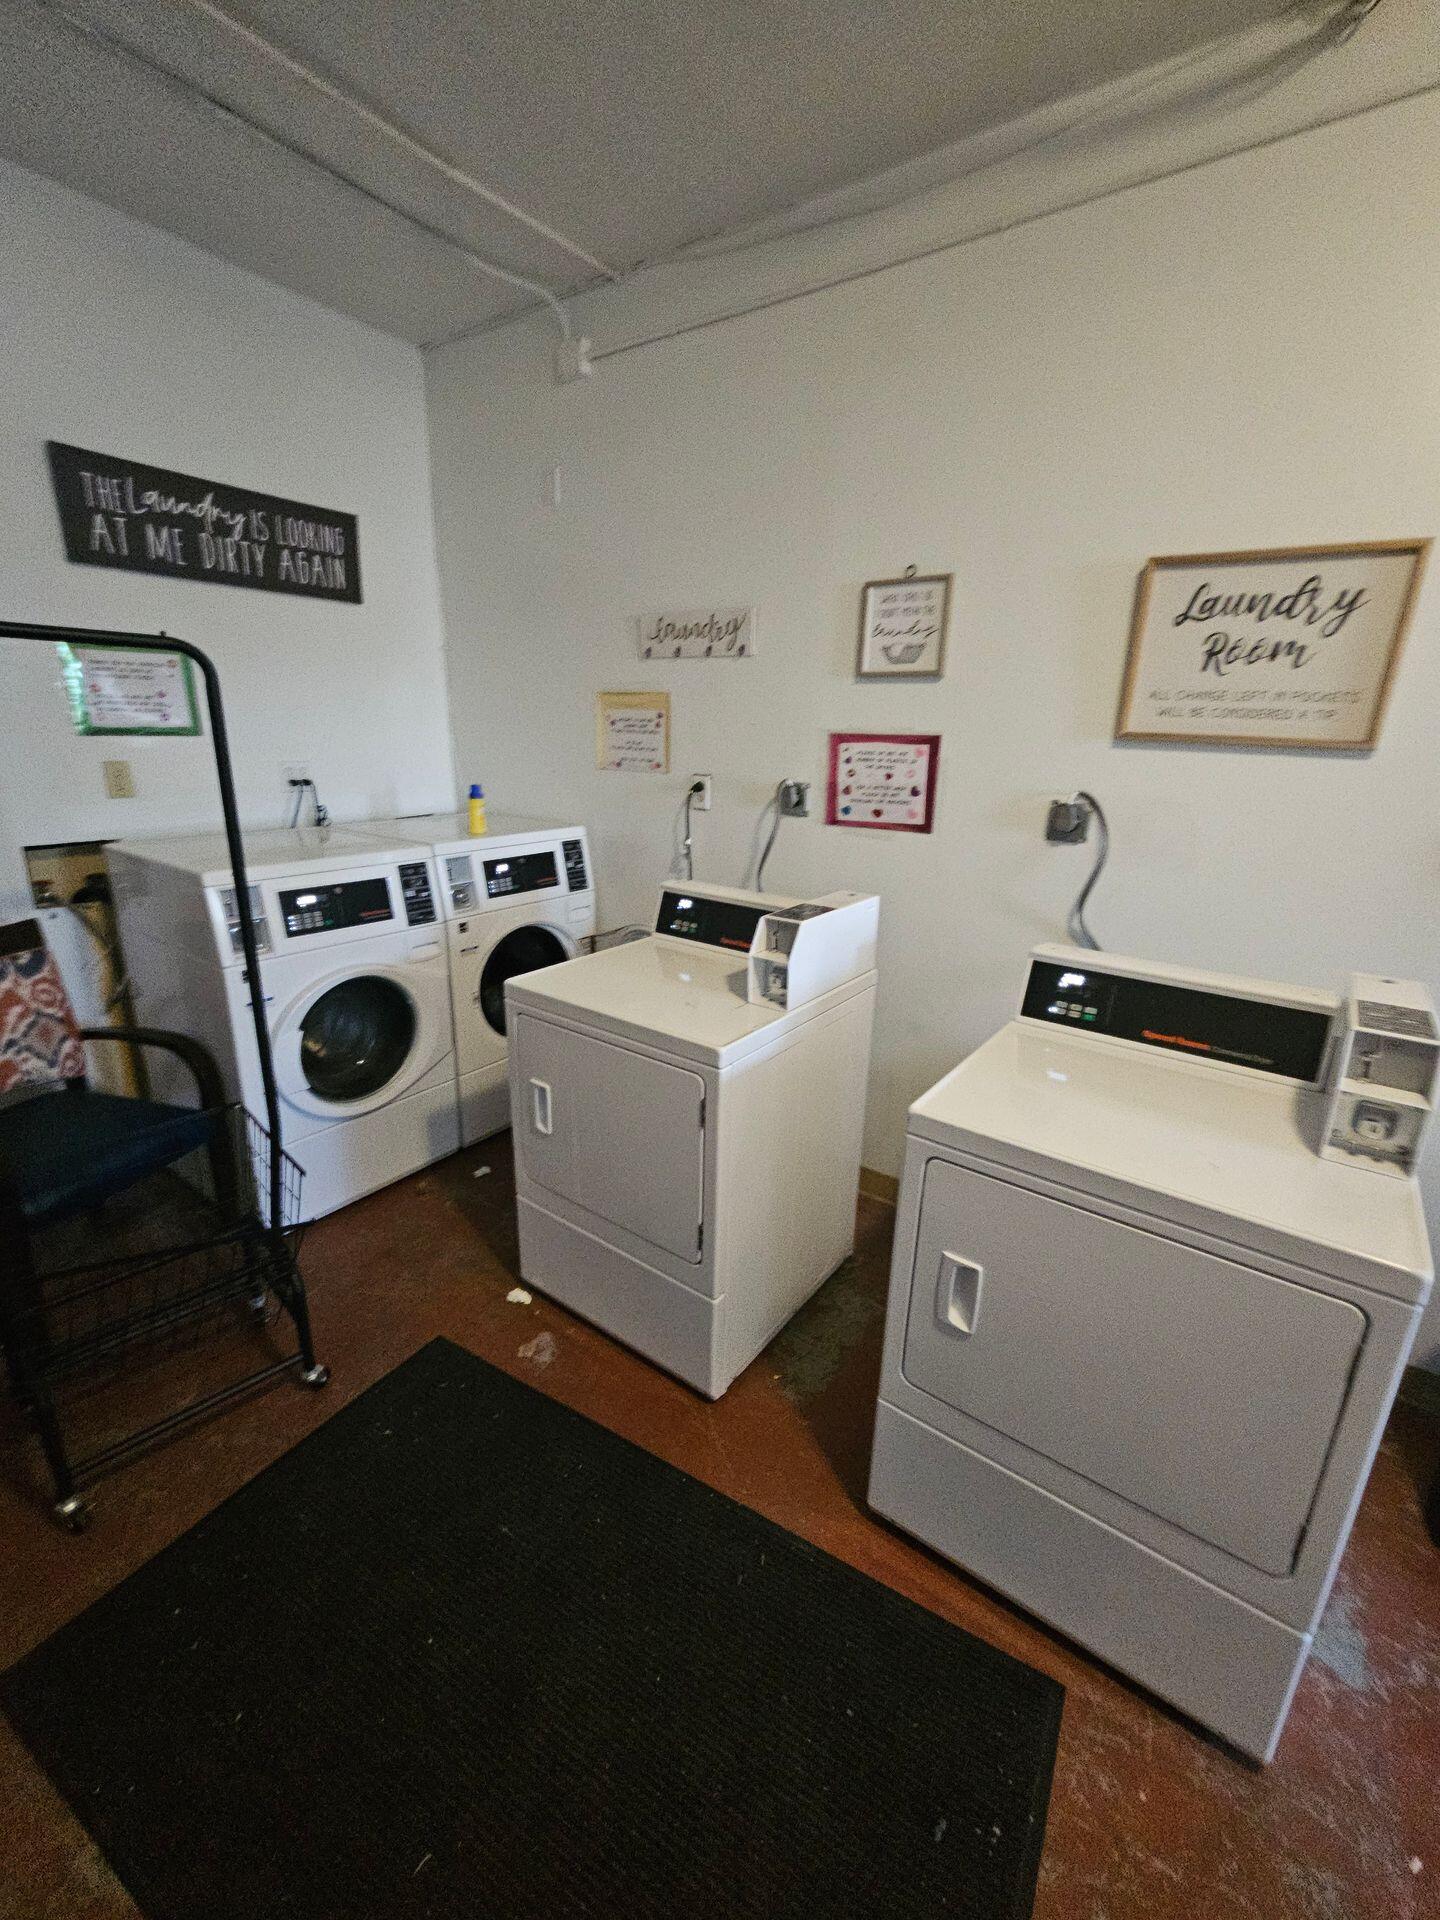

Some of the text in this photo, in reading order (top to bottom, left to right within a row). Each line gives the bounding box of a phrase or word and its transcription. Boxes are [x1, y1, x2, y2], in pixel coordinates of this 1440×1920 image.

[79, 471, 344, 555] THE Laundry IS LOOKING
[89, 513, 347, 589] AT ME DIRTY AGAIN
[1173, 574, 1371, 638] Laundry
[1200, 631, 1316, 677] Room
